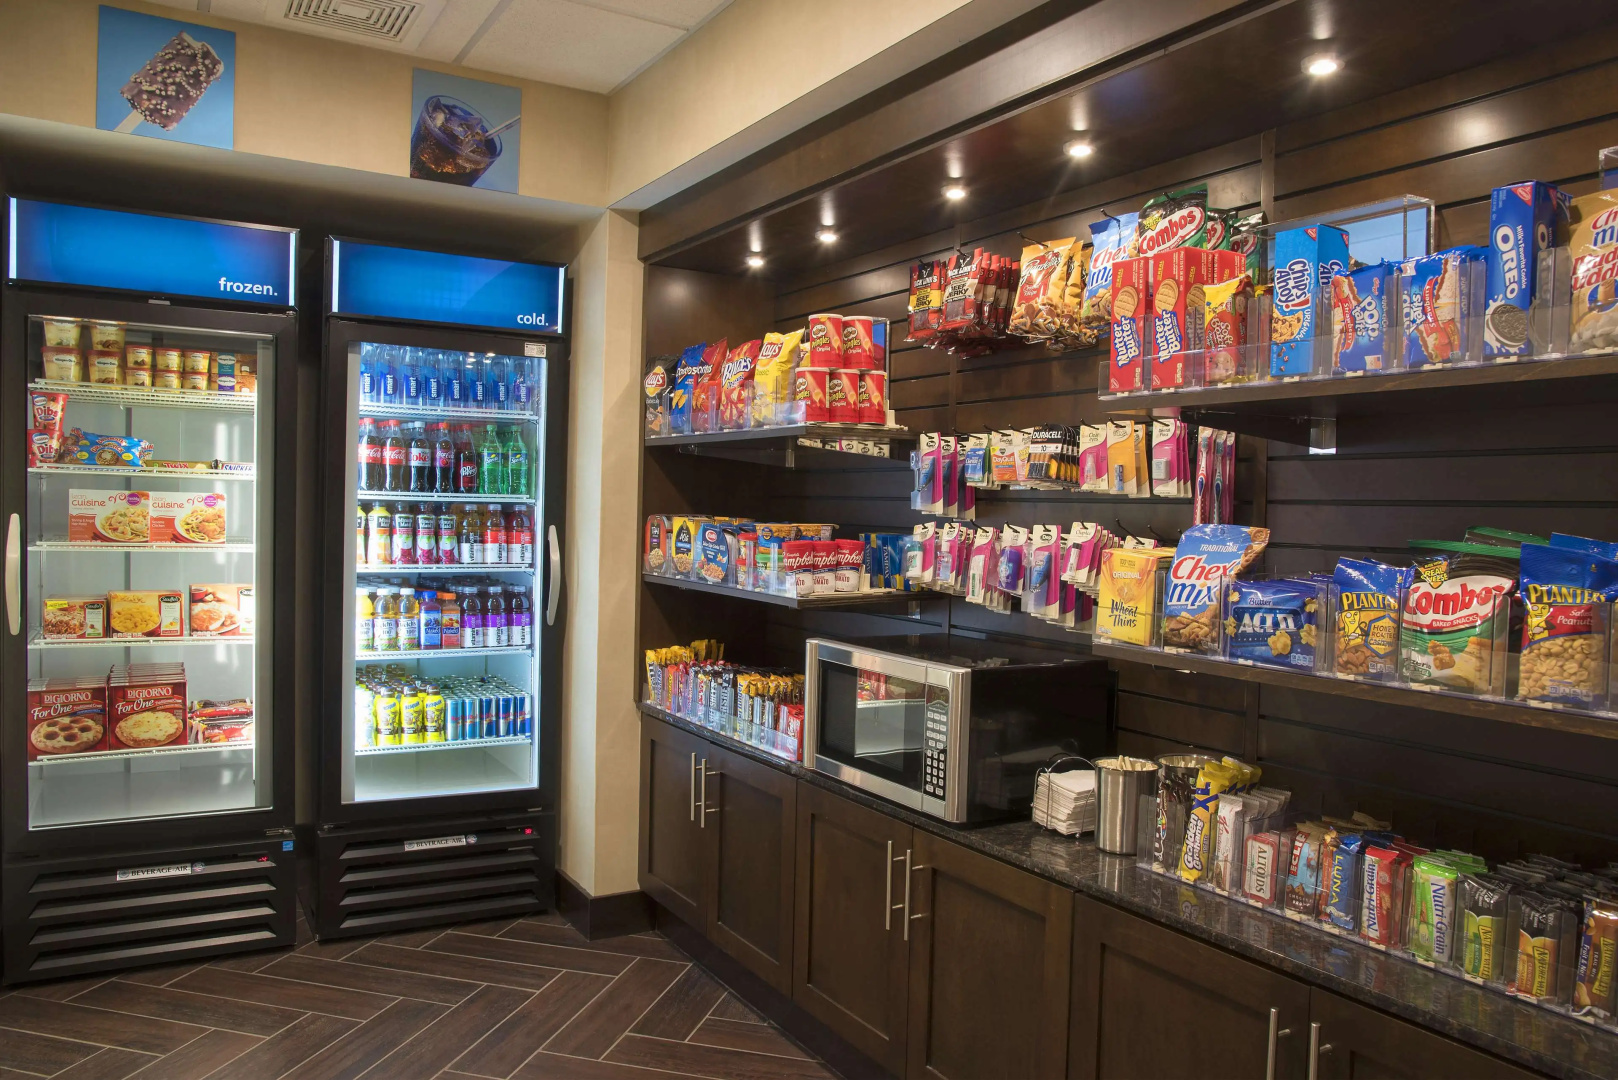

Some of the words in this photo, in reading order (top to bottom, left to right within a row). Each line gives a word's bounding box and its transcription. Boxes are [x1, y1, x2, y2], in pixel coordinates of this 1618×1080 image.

[1140, 210, 1197, 254] Combos
[1496, 225, 1519, 299] OREO
[1518, 243, 1526, 270] Favorite
[219, 277, 278, 296] frozen.
[1288, 259, 1310, 300] Chips
[516, 312, 549, 327] cold.
[1343, 302, 1354, 344] Strawberry
[1351, 304, 1366, 337] tarts
[812, 335, 830, 350] Pringles
[1122, 317, 1140, 358] Butter
[1155, 317, 1171, 363] Nutter
[1162, 310, 1181, 354] Butter
[1114, 323, 1129, 367] Nutter
[363, 372, 371, 394] smart
[386, 374, 394, 395] smart
[36, 405, 59, 417] Dibs
[1032, 431, 1062, 439] DURACELL
[71, 499, 106, 507] cuisine
[152, 501, 185, 509] cuisine
[1200, 544, 1239, 553] TRADITIONAL
[1112, 571, 1141, 579] ORIGINAL
[1171, 555, 1237, 581] Chex
[1425, 567, 1445, 577] REAL
[1169, 581, 1220, 607] mix
[1248, 597, 1272, 606] Butter
[1528, 583, 1608, 604] PLANTERS
[1111, 599, 1138, 618] Wheat
[1109, 614, 1138, 628] Thins
[1239, 612, 1275, 634] ACT
[1373, 624, 1397, 633] HONEY
[1432, 619, 1452, 627] BAKED
[1453, 614, 1479, 626] SNACKS
[1557, 616, 1595, 626] Peanuts
[31, 706, 51, 721] For
[50, 703, 73, 716] One
[115, 701, 134, 715] For
[133, 697, 155, 711] One
[1191, 781, 1220, 813] XL
[1184, 813, 1199, 869] Golden
[1193, 819, 1205, 871] Grahams
[1256, 846, 1268, 894] ALTOIDS
[1330, 855, 1344, 904] LUNA
[1481, 926, 1492, 957] NATURE
[1601, 940, 1616, 971] NATURE
